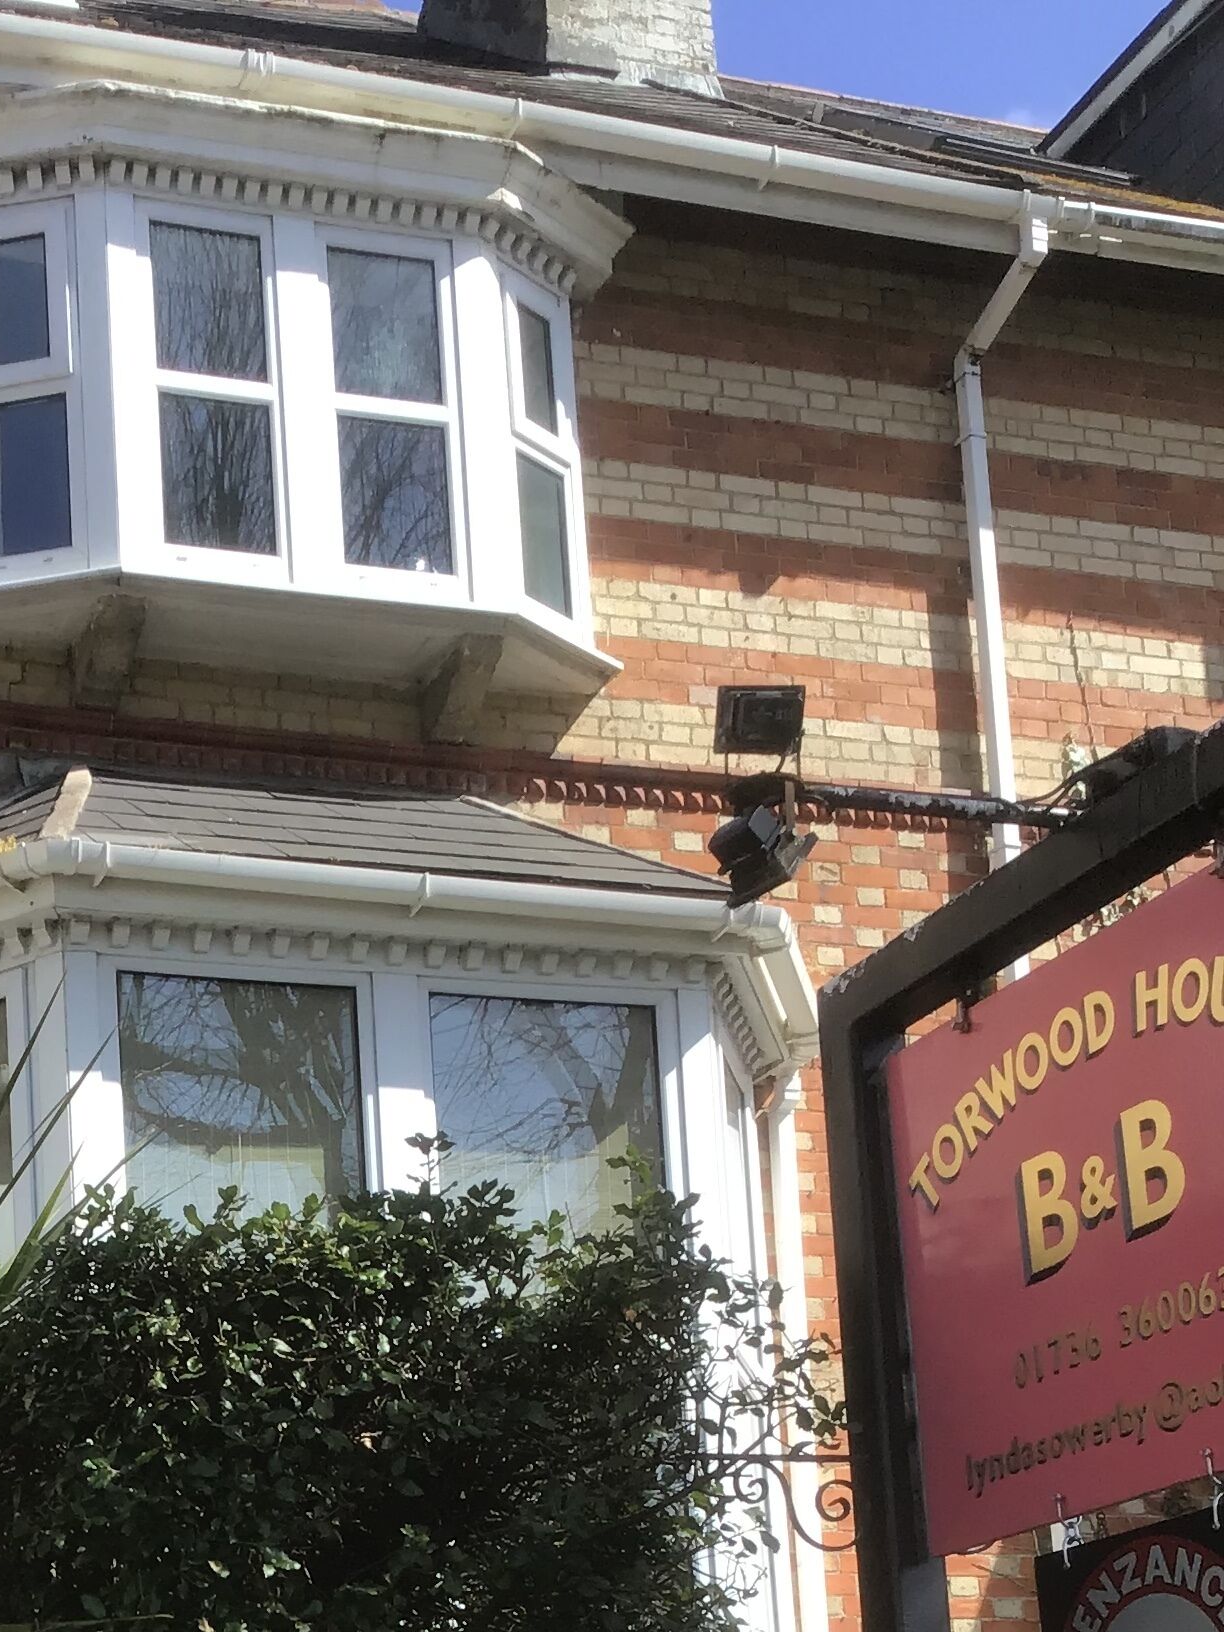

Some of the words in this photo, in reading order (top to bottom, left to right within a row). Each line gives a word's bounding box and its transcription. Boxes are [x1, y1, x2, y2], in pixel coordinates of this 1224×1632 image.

[908, 990, 1116, 1212] TORWOOD
[1018, 1099, 1186, 1283] B&B
[1014, 1321, 1102, 1389] 01736
